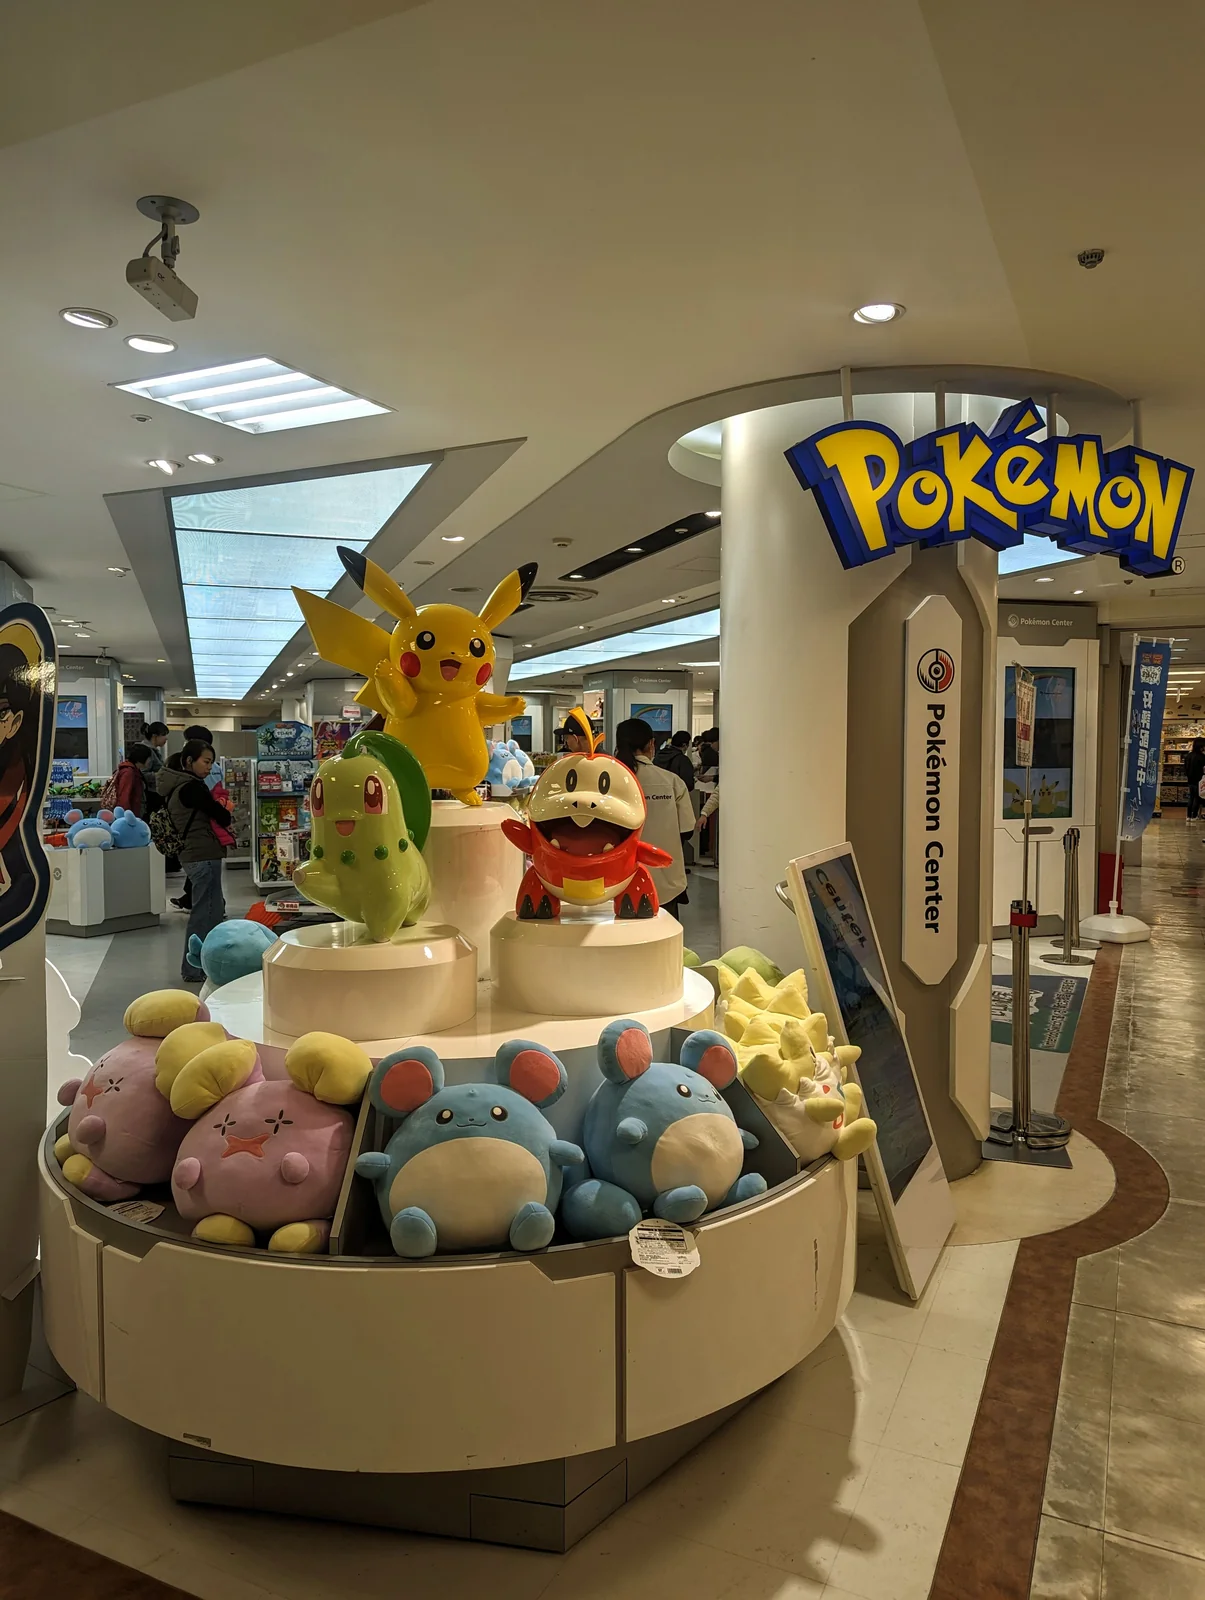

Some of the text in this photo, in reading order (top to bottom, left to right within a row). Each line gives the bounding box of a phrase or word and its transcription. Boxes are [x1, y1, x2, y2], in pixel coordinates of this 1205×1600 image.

[1020, 617, 1074, 627] Pokémon Center
[924, 703, 948, 934] Pokémon Center
